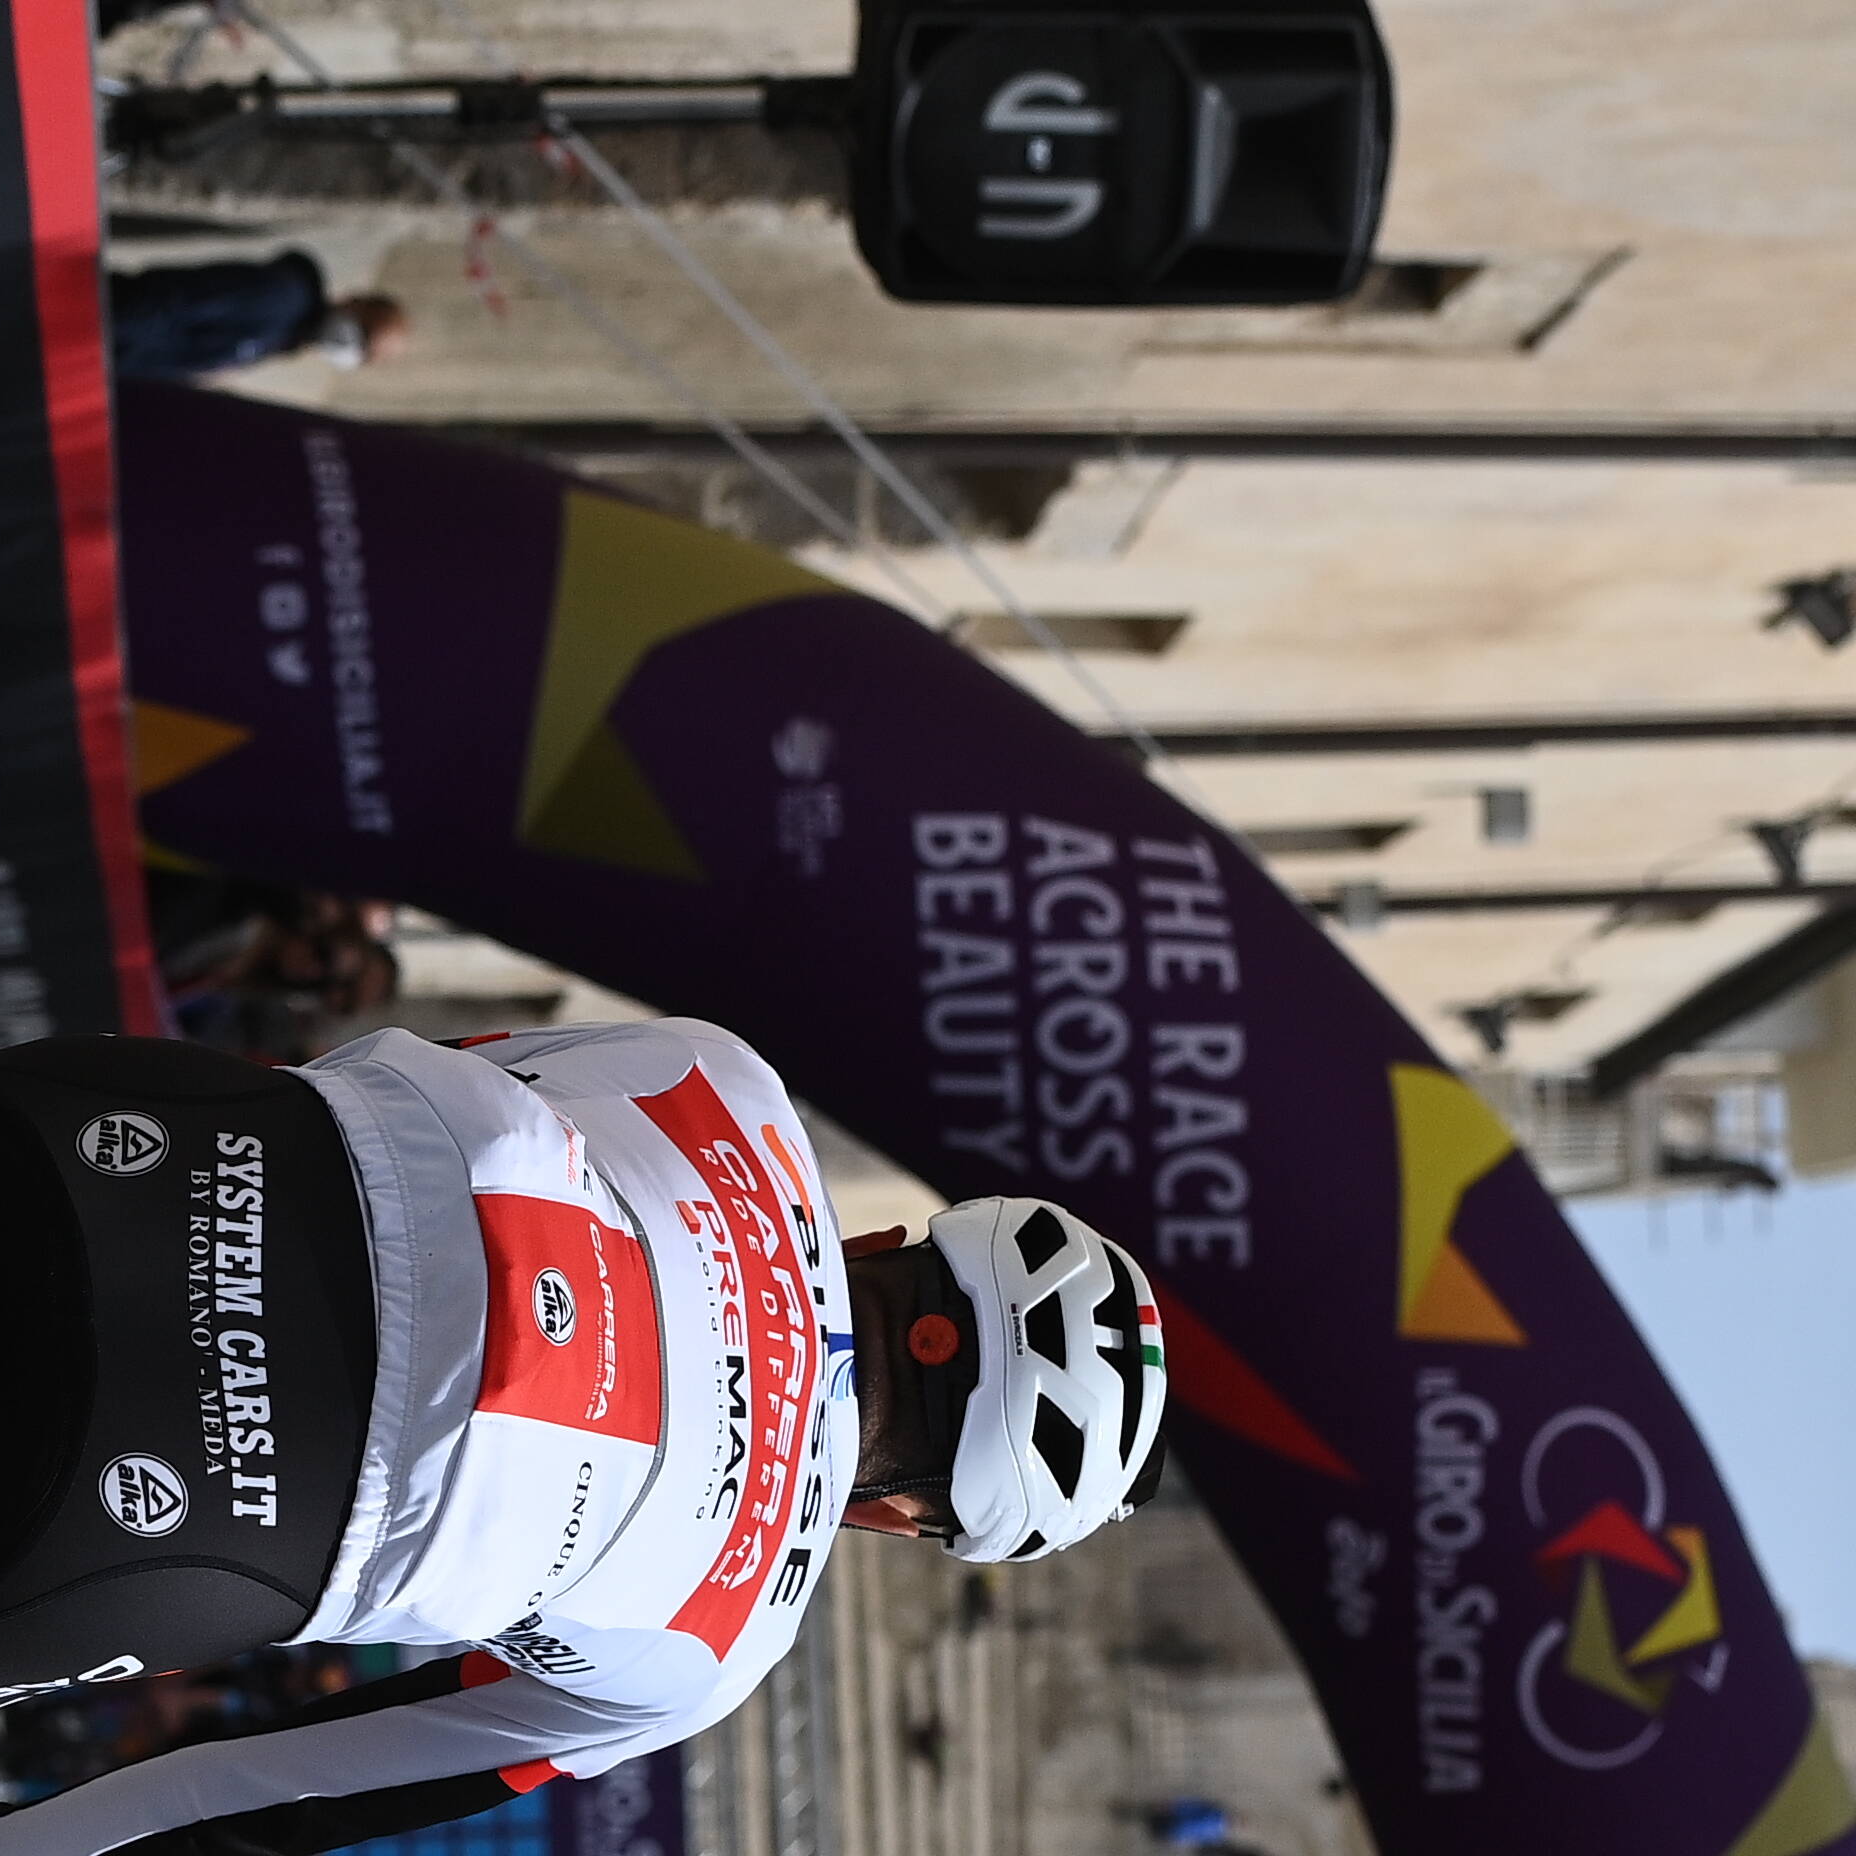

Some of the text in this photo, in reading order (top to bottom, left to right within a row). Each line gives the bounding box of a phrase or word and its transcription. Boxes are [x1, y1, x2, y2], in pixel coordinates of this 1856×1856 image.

[912, 811, 1028, 1169] BEAUTY
[1022, 814, 1135, 1179] ACROSS
[1130, 838, 1252, 1269] THE RACE
[95, 1119, 120, 1170] alka
[190, 1168, 211, 1207] BY
[698, 1147, 761, 1256] RIDE
[214, 1132, 277, 1527] SYSTEM CARS.IT
[540, 1279, 558, 1333] alka
[588, 1222, 616, 1421] CARRERA
[692, 1200, 747, 1521] PREMAC
[696, 1241, 718, 1332] solid
[713, 1139, 806, 1592] CARRERA
[117, 1463, 142, 1529] alka
[198, 1387, 226, 1476] MEDA
[696, 1360, 724, 1521] thinking
[720, 1289, 784, 1591] DIFFERENT
[1416, 1393, 1500, 1552] GIRO
[547, 1461, 593, 1577] CINQUE
[1416, 1584, 1499, 1795] SICILIA
